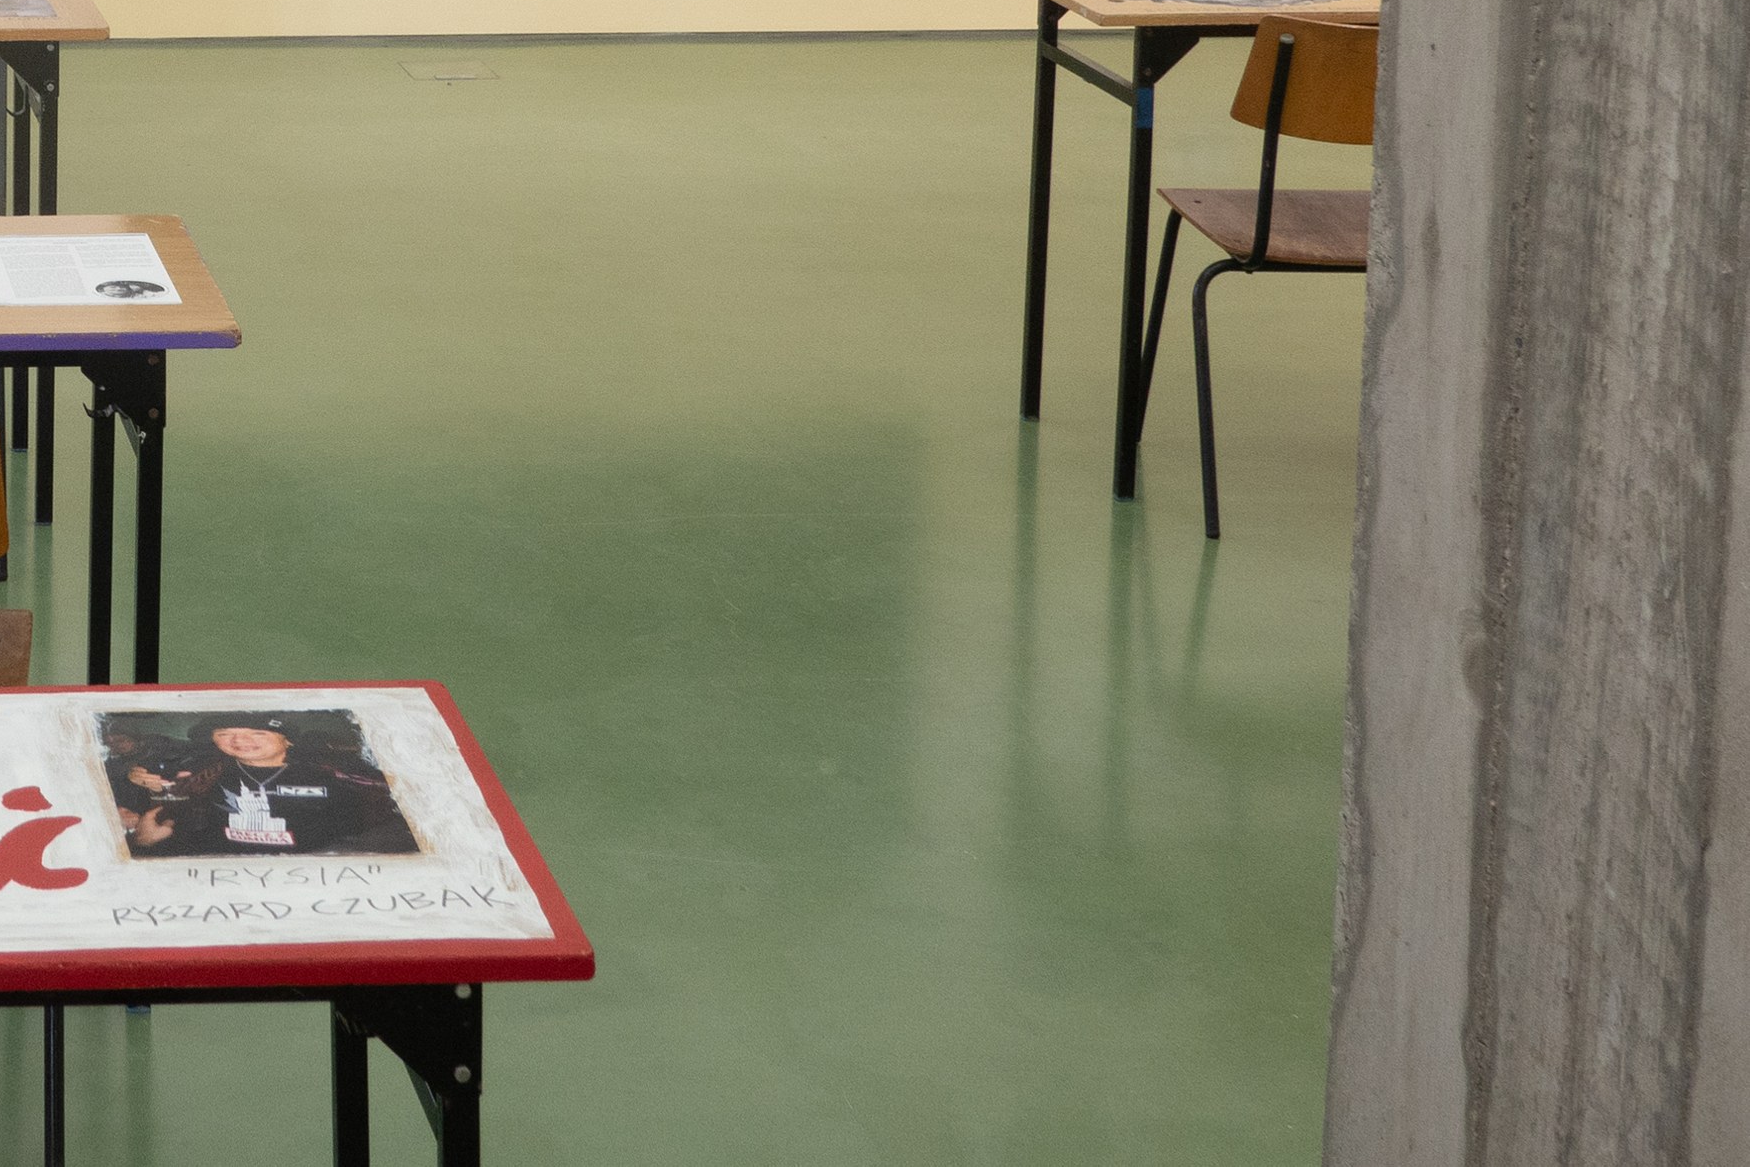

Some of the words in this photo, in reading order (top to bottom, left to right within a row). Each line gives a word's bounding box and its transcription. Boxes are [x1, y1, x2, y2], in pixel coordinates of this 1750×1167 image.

[187, 865, 382, 887] "RYSIA"
[112, 901, 292, 926] RYSZARD
[310, 885, 516, 915] CZUBAK
